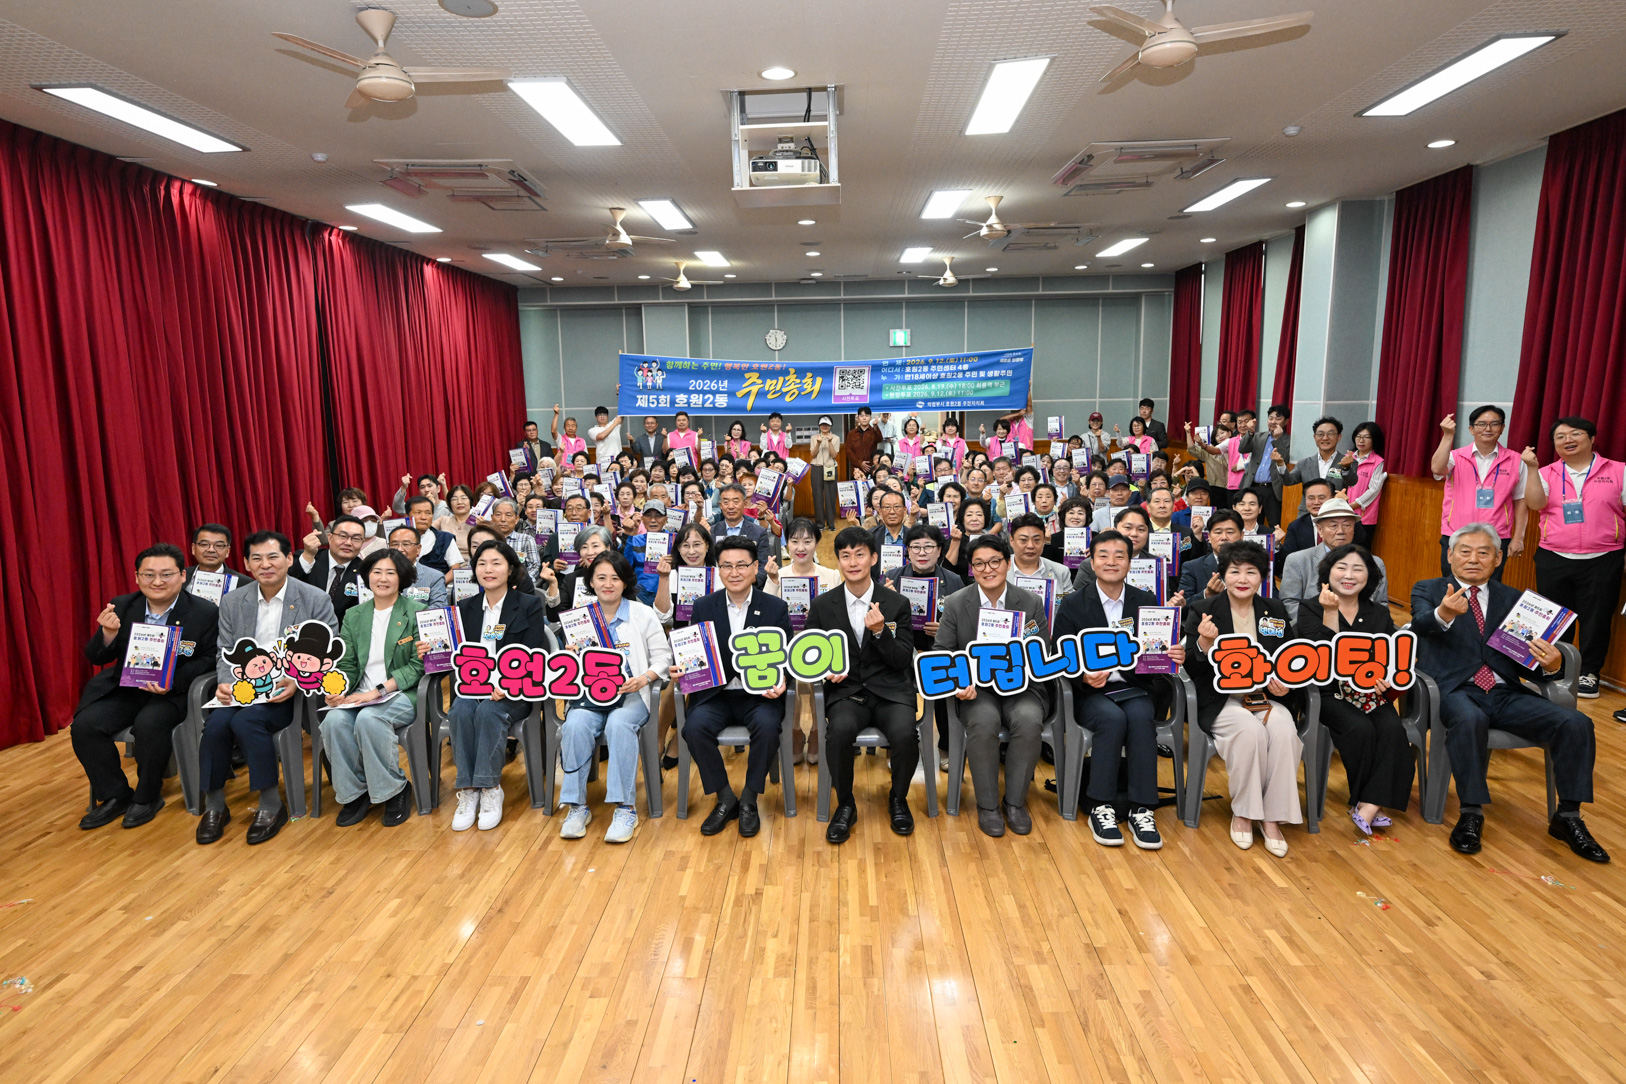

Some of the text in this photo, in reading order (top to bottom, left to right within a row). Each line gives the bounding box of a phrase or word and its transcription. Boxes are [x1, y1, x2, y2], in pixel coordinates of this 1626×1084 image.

[666, 361, 698, 370] 함께하는
[701, 362, 722, 370] 주민!
[689, 380, 728, 391] 2026년
[736, 368, 822, 412] 주민총회
[636, 394, 728, 408] 제5회 호원2동
[454, 645, 625, 703] 호원2동
[732, 631, 846, 691] 꿈이
[917, 631, 1140, 696] 터집니다
[1213, 634, 1413, 690] 화이팅!
